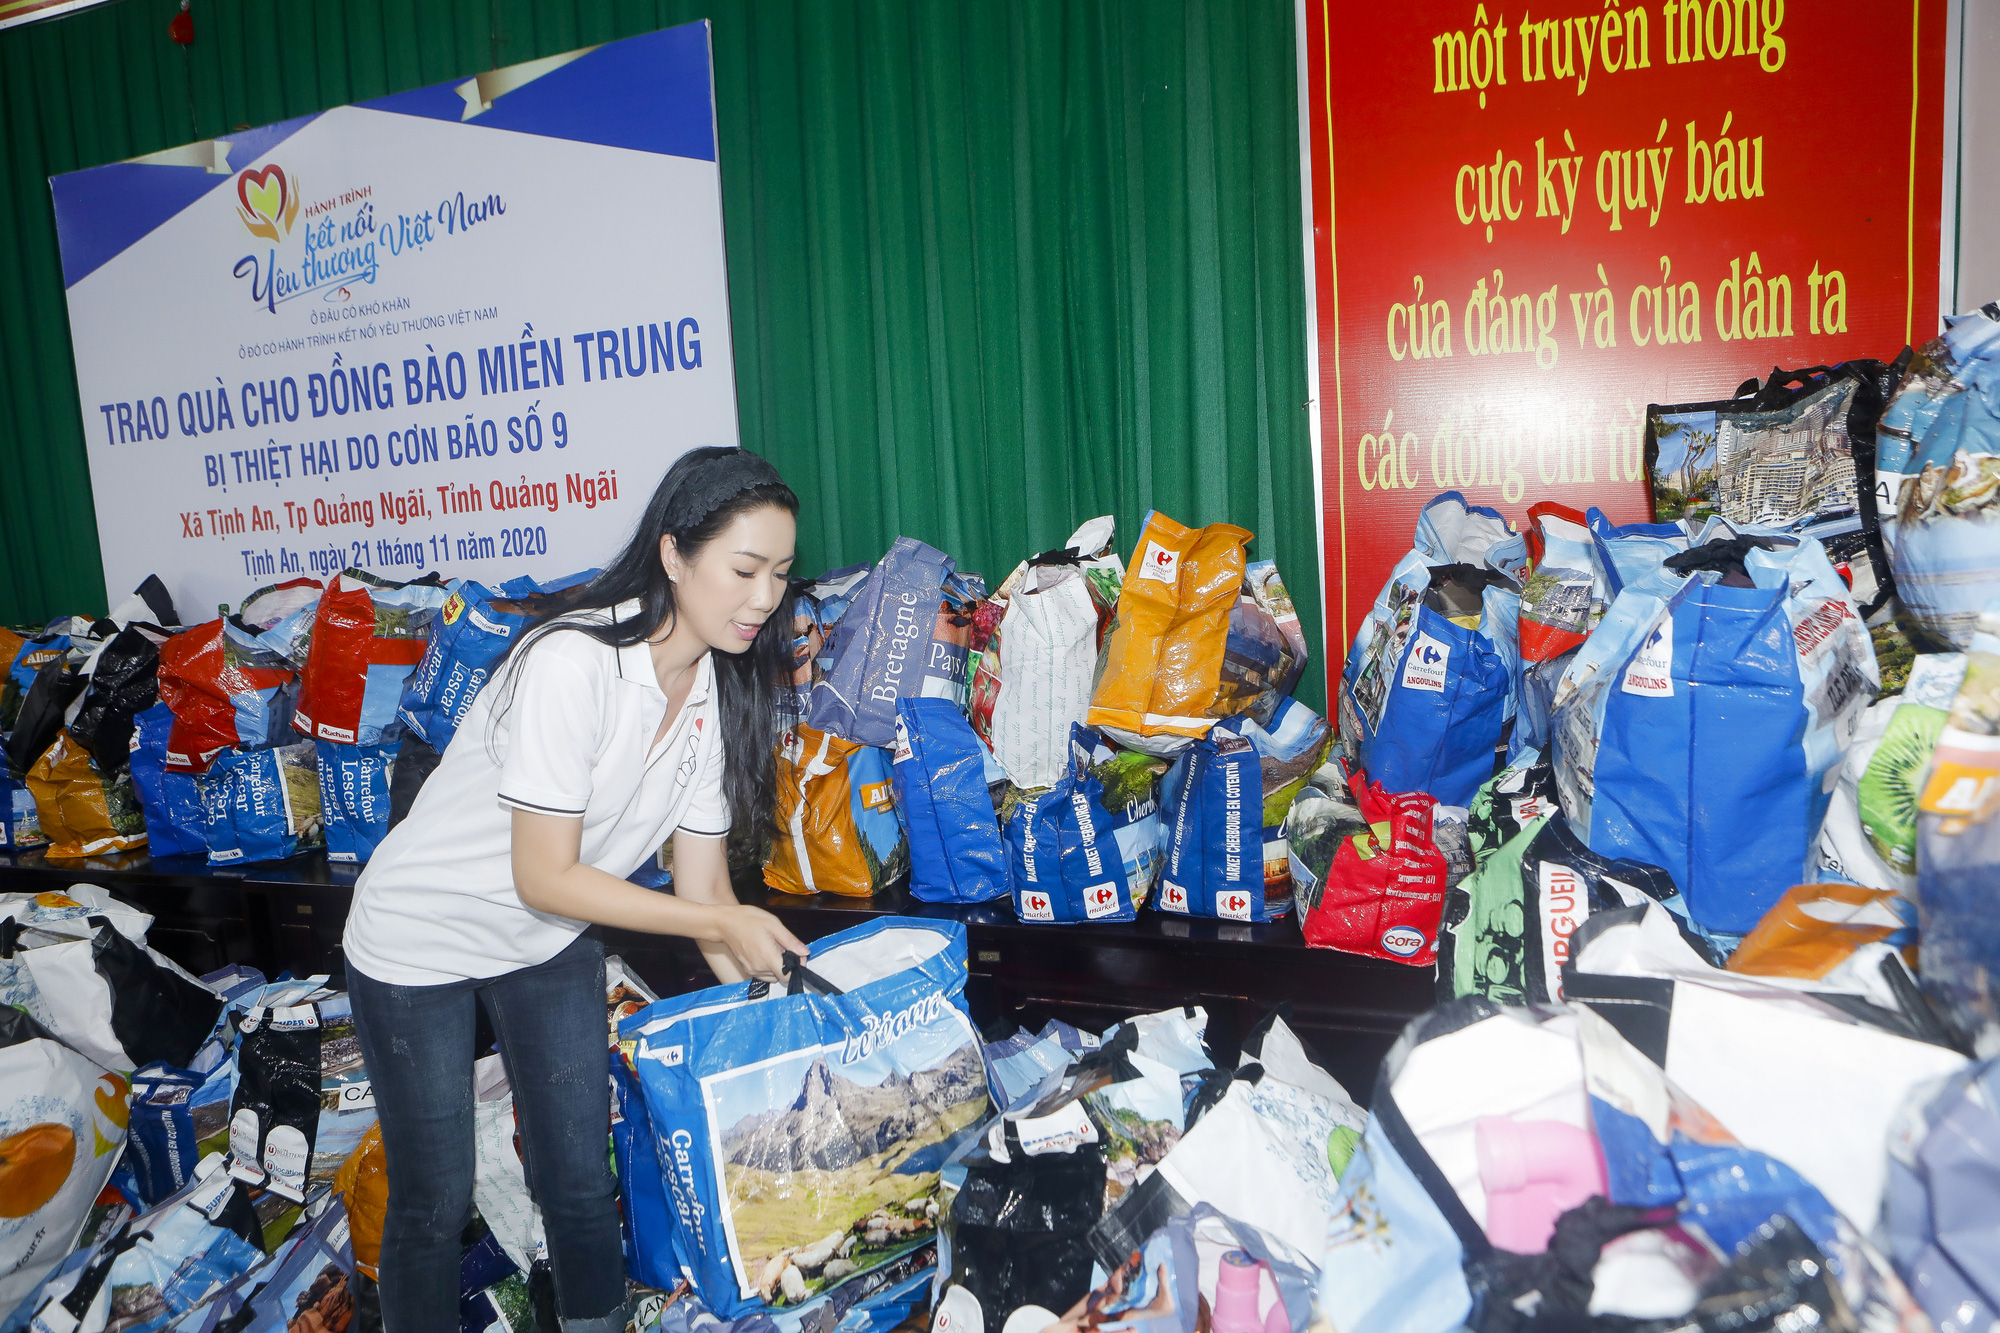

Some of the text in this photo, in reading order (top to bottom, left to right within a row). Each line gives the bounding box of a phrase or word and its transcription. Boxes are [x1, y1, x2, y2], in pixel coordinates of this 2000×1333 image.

[1432, 2, 1508, 110] một
[1454, 110, 1765, 244] cực kỳ quý báu
[305, 185, 372, 219] HÀNH TRÌNH
[305, 201, 377, 256] kết nối
[233, 191, 507, 315] Yêu thương Việt Nam
[278, 337, 305, 353] HÀNH
[306, 332, 336, 348] TRÌNH
[379, 320, 400, 336] YÊU
[447, 308, 471, 326] VIỆT
[474, 306, 498, 321] NAM
[1387, 250, 1848, 371] của đảng và của dân ta
[100, 317, 703, 446] TRAO QUÀ CHO ĐỒNG BÀO MIỀN TRUNG
[204, 400, 569, 493] BỊ THIỆT HẠI DO CƠN BÃO SỐ 9
[1357, 408, 1419, 492] các
[179, 469, 618, 541] Xã Tịnh An, Tp Quảng Ngãi, Tỉnh Quảng Ngãi
[241, 525, 547, 581] Tịnh An, ngày 21 tháng 11 năm 2020
[27, 650, 61, 664] Allau
[871, 592, 918, 705] Bretagne
[927, 642, 962, 680] Pays
[1407, 662, 1445, 677] Carrefour
[1637, 656, 1668, 669] refour
[418, 647, 443, 704] Lescar
[441, 660, 471, 716] Lescar
[1406, 676, 1442, 689] ANGOULINS
[321, 727, 351, 739] Auchan
[234, 760, 249, 812] Lecar
[248, 752, 266, 817] Carrefour
[327, 764, 345, 822] Lescar
[341, 760, 359, 820] Lescar
[360, 757, 376, 825] Carrefour
[1226, 761, 1241, 799] COTENTIN
[1074, 803, 1096, 847] CHERBOURG
[1126, 788, 1156, 823] Cherb
[1171, 753, 1198, 877] MARKET CHERBOURG EN COTENTIN
[1226, 799, 1241, 810] EN
[1226, 810, 1241, 854] CHERBOURG
[1023, 853, 1038, 883] MARKET
[1084, 846, 1103, 877] MARKET
[1226, 854, 1241, 882] MARKET
[1089, 900, 1117, 915] market
[1161, 900, 1186, 912] market
[1219, 911, 1248, 920] market
[1385, 935, 1422, 947] cora
[840, 1026, 873, 1067] Le
[344, 1085, 376, 1101] CA
[275, 1165, 304, 1177] location
[659, 1132, 694, 1235] Lescar
[671, 1128, 706, 1256] Carrefour
[16, 1226, 46, 1268] four.fr
